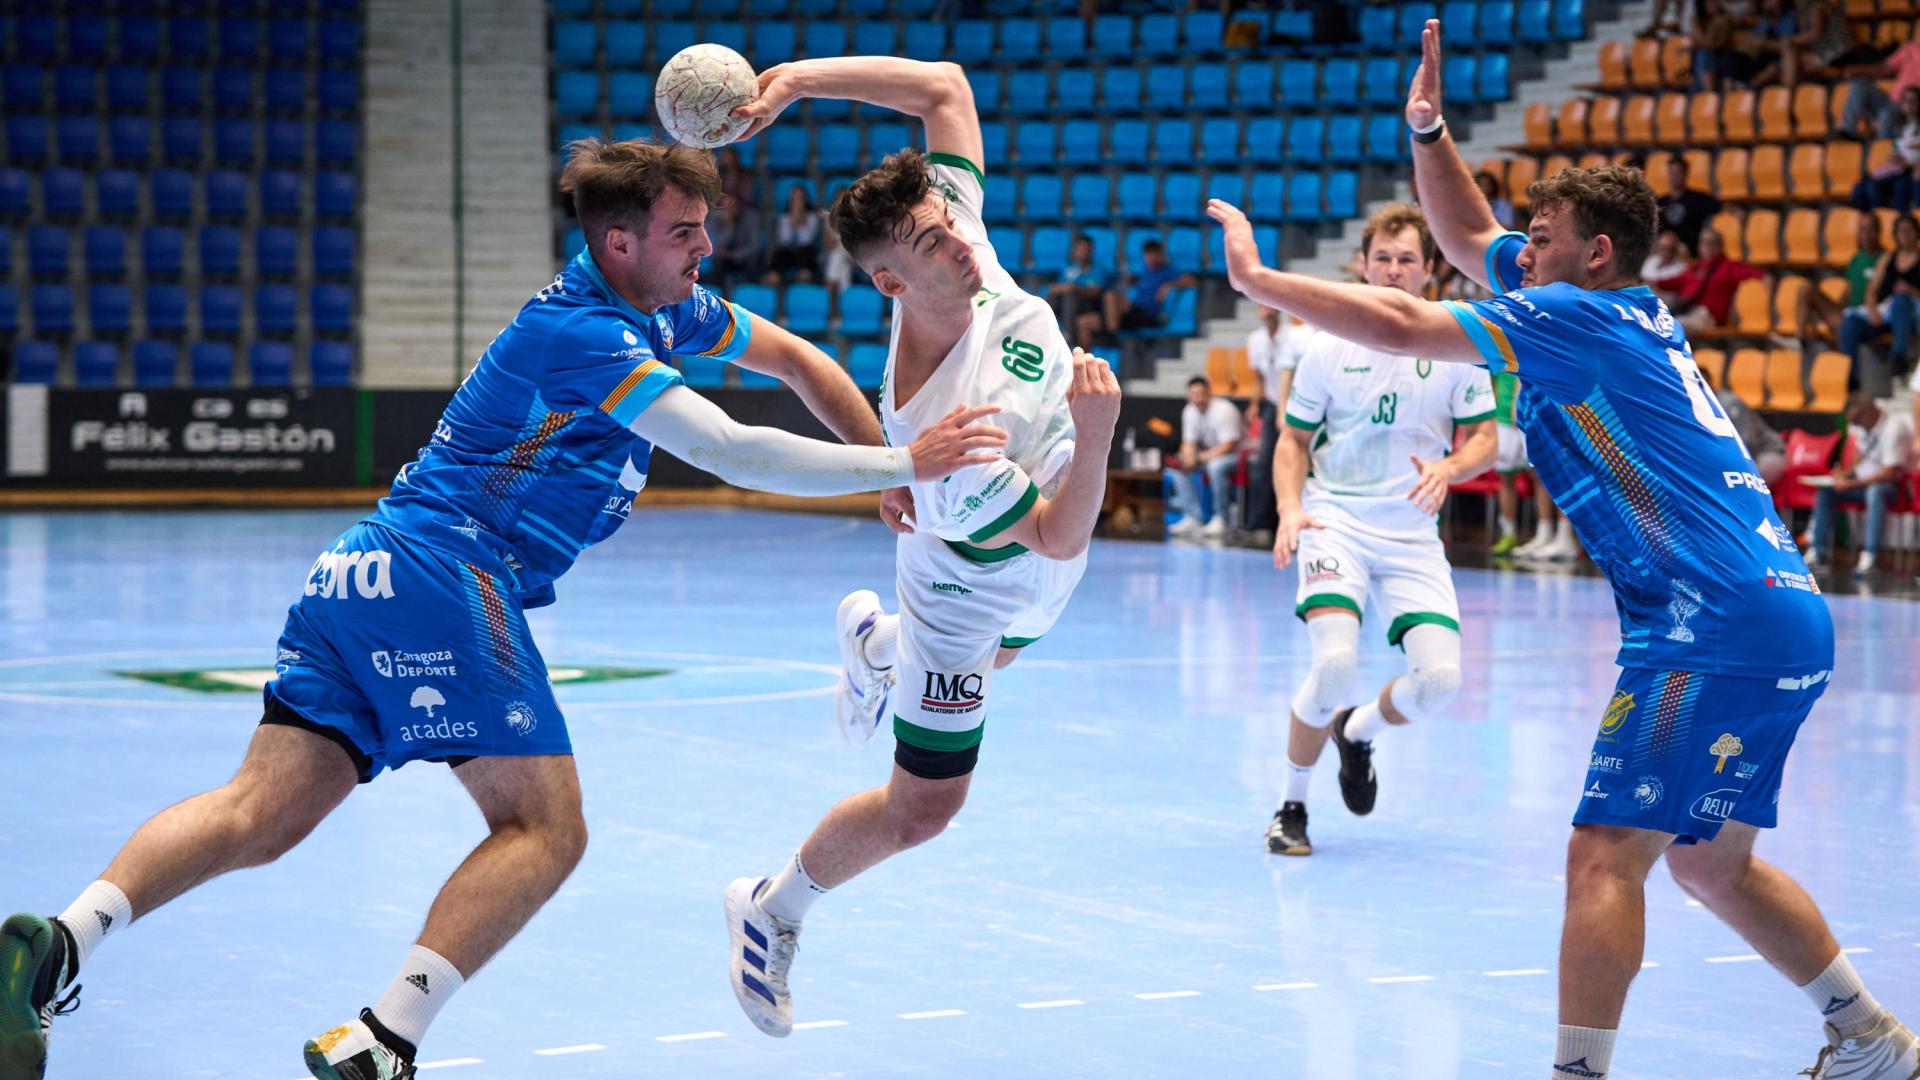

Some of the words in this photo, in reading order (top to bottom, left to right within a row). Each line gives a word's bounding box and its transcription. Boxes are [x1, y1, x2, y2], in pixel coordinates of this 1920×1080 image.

[71, 421, 171, 451] Félix
[183, 421, 335, 451] Gastón
[394, 650, 453, 665] Zaragoza
[922, 670, 984, 701] IMQ
[920, 704, 956, 715] IGUALATORIO
[400, 716, 478, 742] atades
[1553, 1063, 1605, 1079] MERCURY
